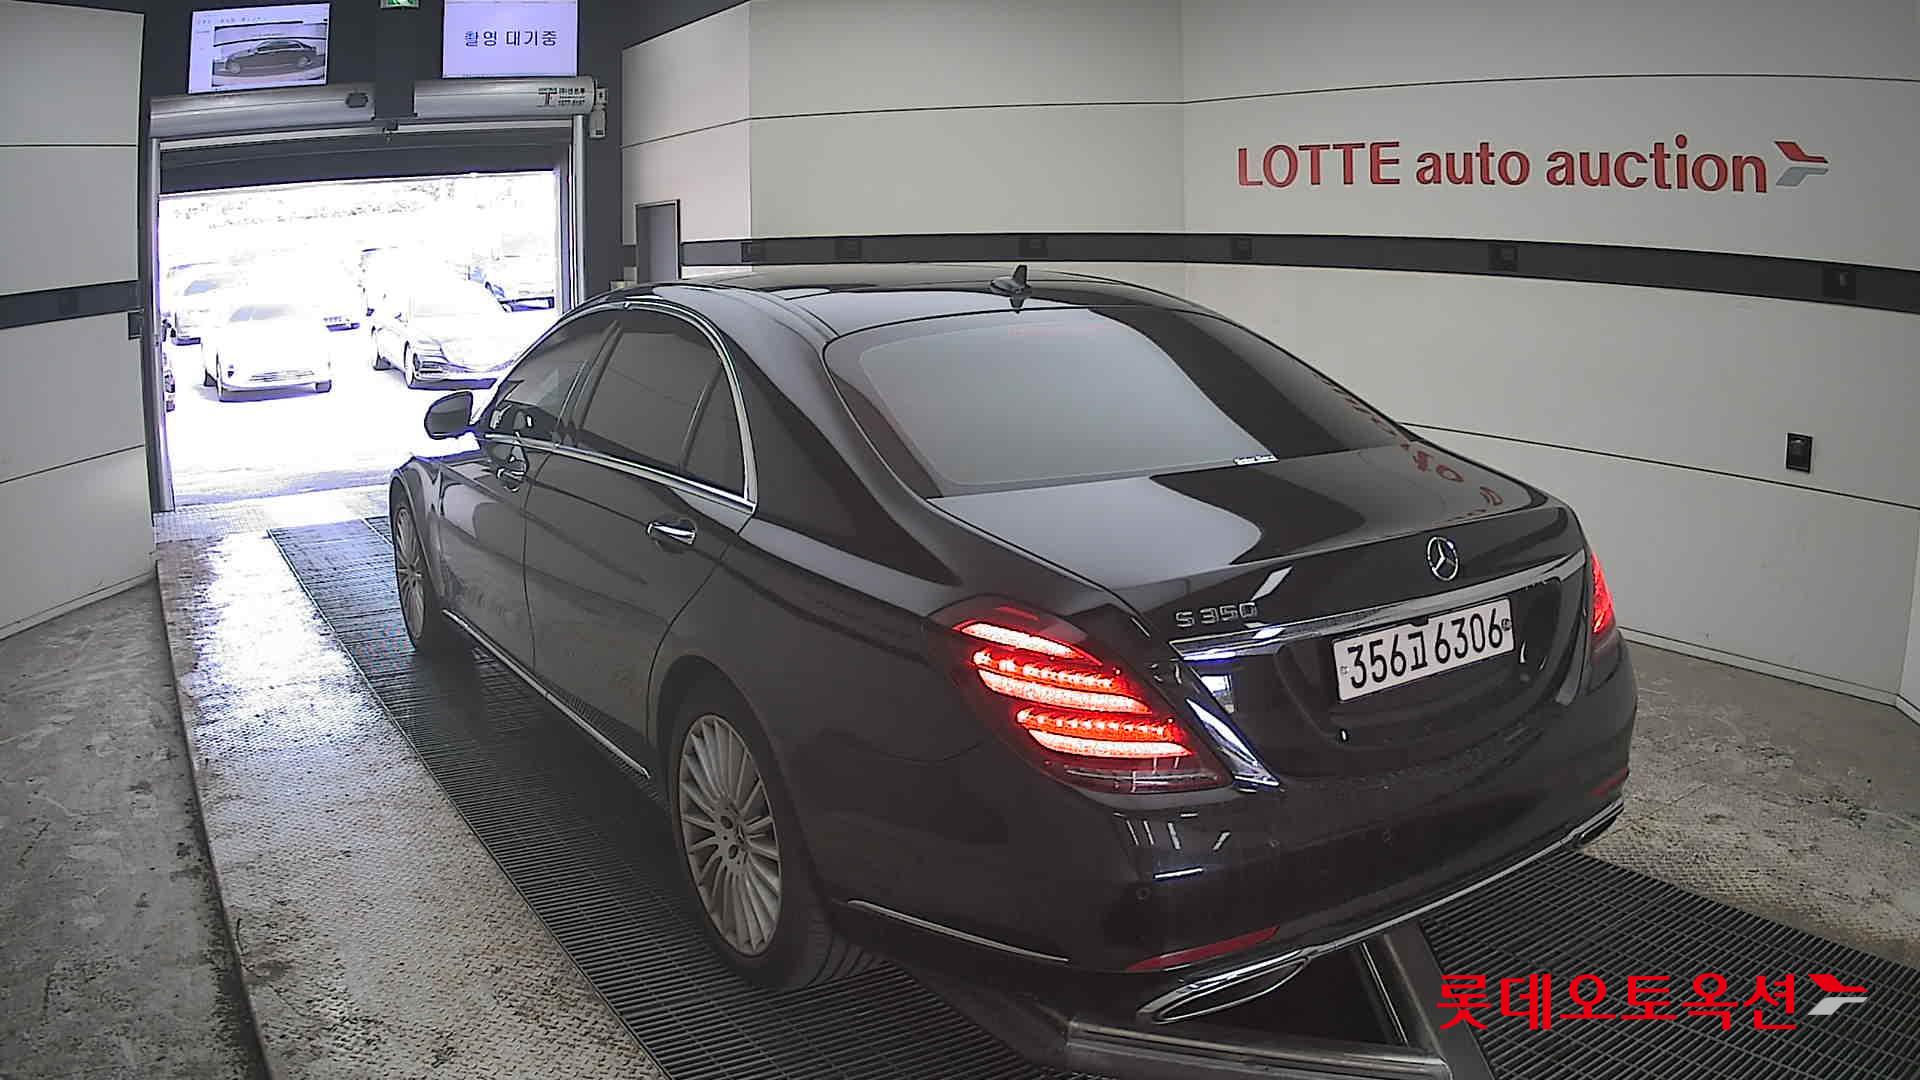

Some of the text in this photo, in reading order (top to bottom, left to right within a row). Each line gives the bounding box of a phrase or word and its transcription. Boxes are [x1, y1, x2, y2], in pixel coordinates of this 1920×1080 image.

[505, 30, 558, 47] 대기중
[1238, 134, 1768, 193] LOTTE auto auction
[1175, 602, 1258, 628] S 350
